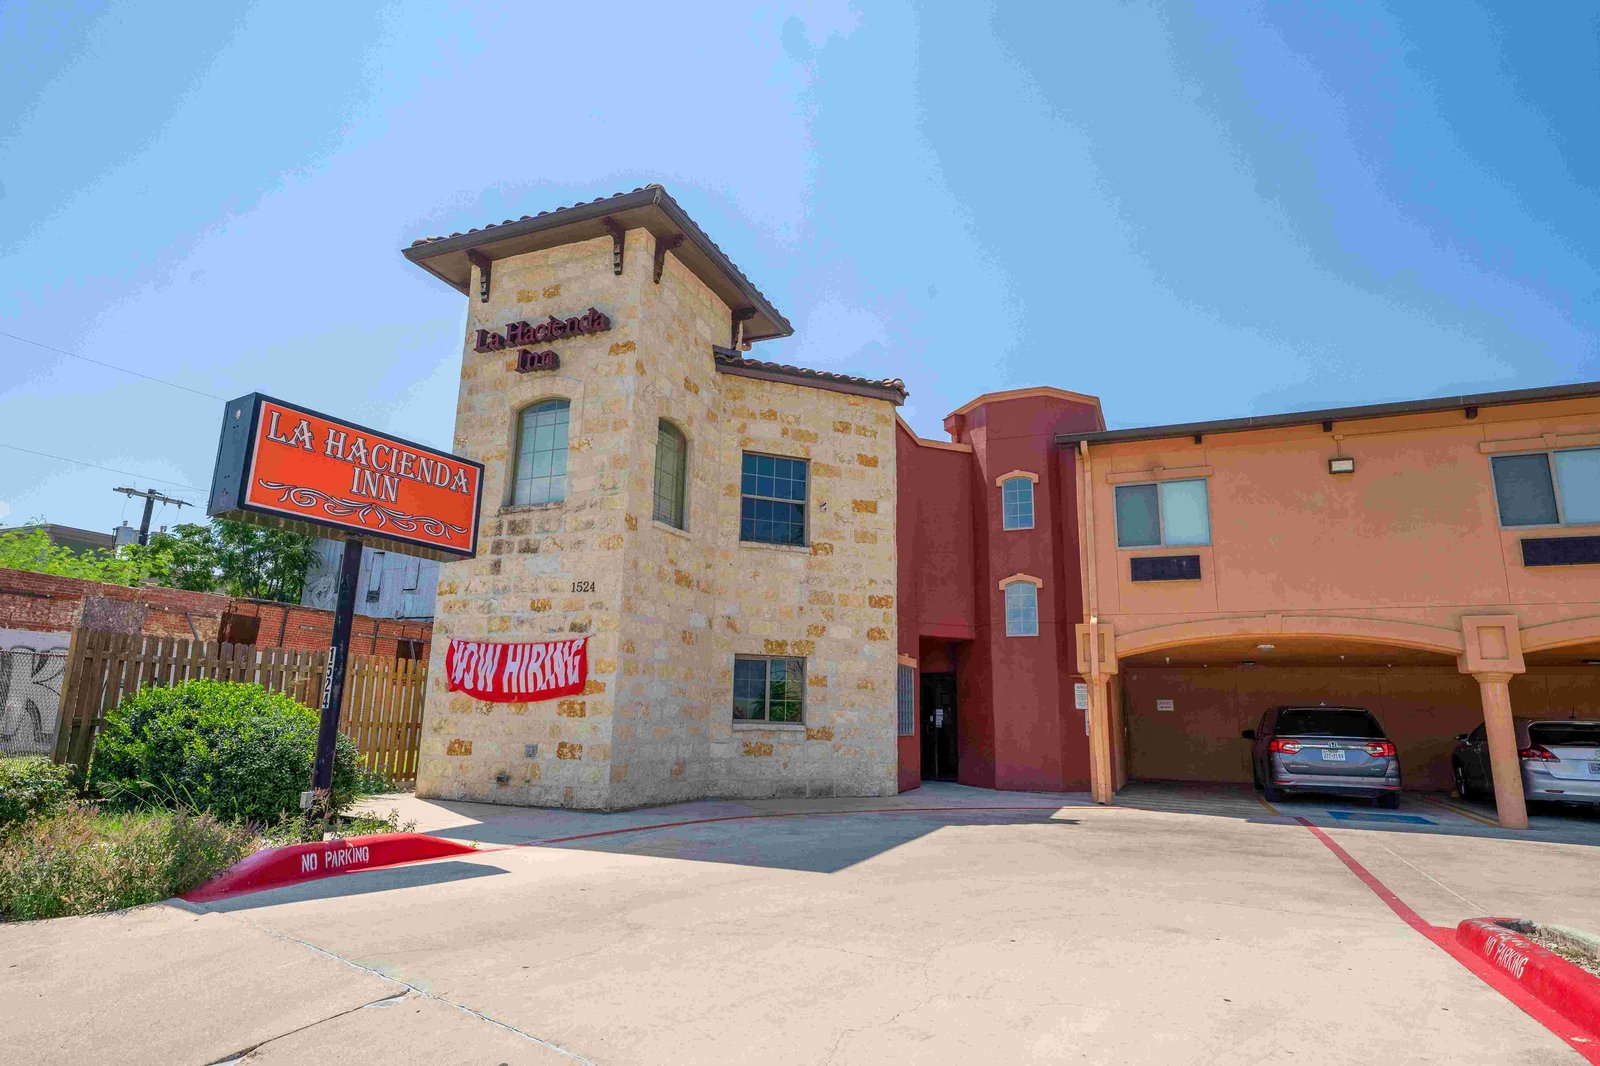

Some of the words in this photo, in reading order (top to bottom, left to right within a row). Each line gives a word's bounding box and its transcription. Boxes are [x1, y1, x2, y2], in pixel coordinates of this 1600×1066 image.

[474, 328, 505, 353] La
[505, 307, 611, 347] Hacienda
[515, 349, 560, 373] Inn
[266, 410, 315, 452] LA
[324, 428, 470, 495] HACIENDA
[350, 467, 400, 504] INN
[570, 581, 596, 593] 1524
[322, 647, 336, 708] 1524
[502, 639, 585, 693] HIRING
[301, 853, 318, 873] NO
[325, 846, 369, 868] PARKING
[1483, 936, 1497, 956] NO
[1493, 943, 1529, 979] PARKING
